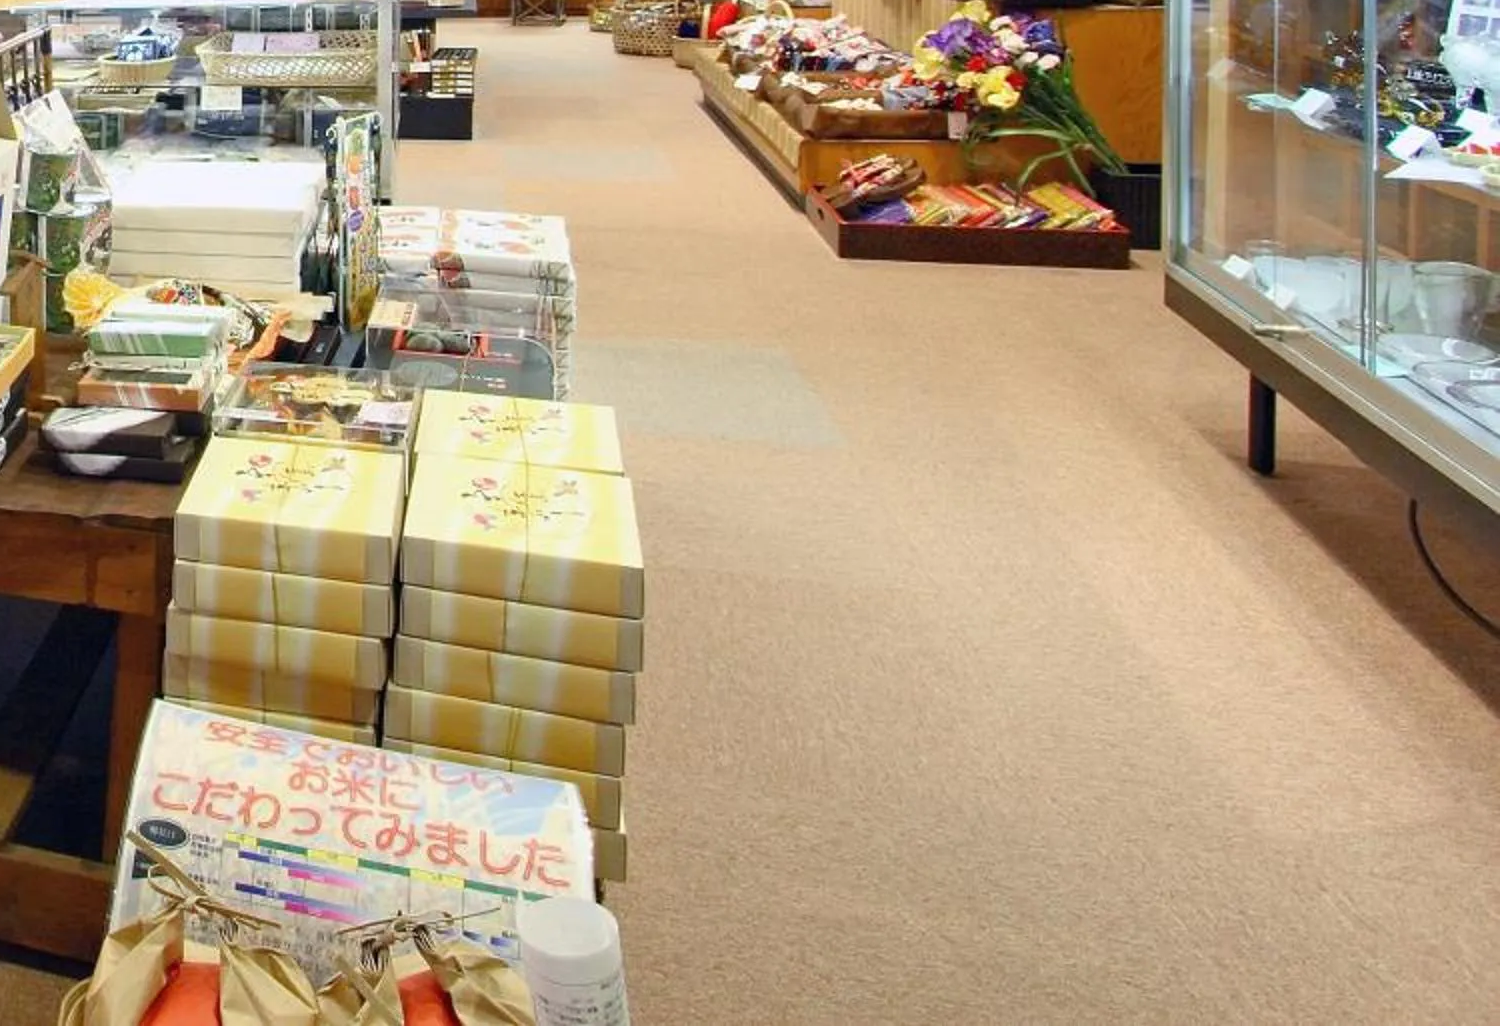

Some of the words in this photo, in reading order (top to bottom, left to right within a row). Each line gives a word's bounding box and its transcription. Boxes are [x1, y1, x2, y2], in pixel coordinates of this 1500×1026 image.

[206, 720, 515, 795] 安全でおいしい
[288, 759, 421, 812] お米に
[150, 771, 573, 888] こだわってみました
